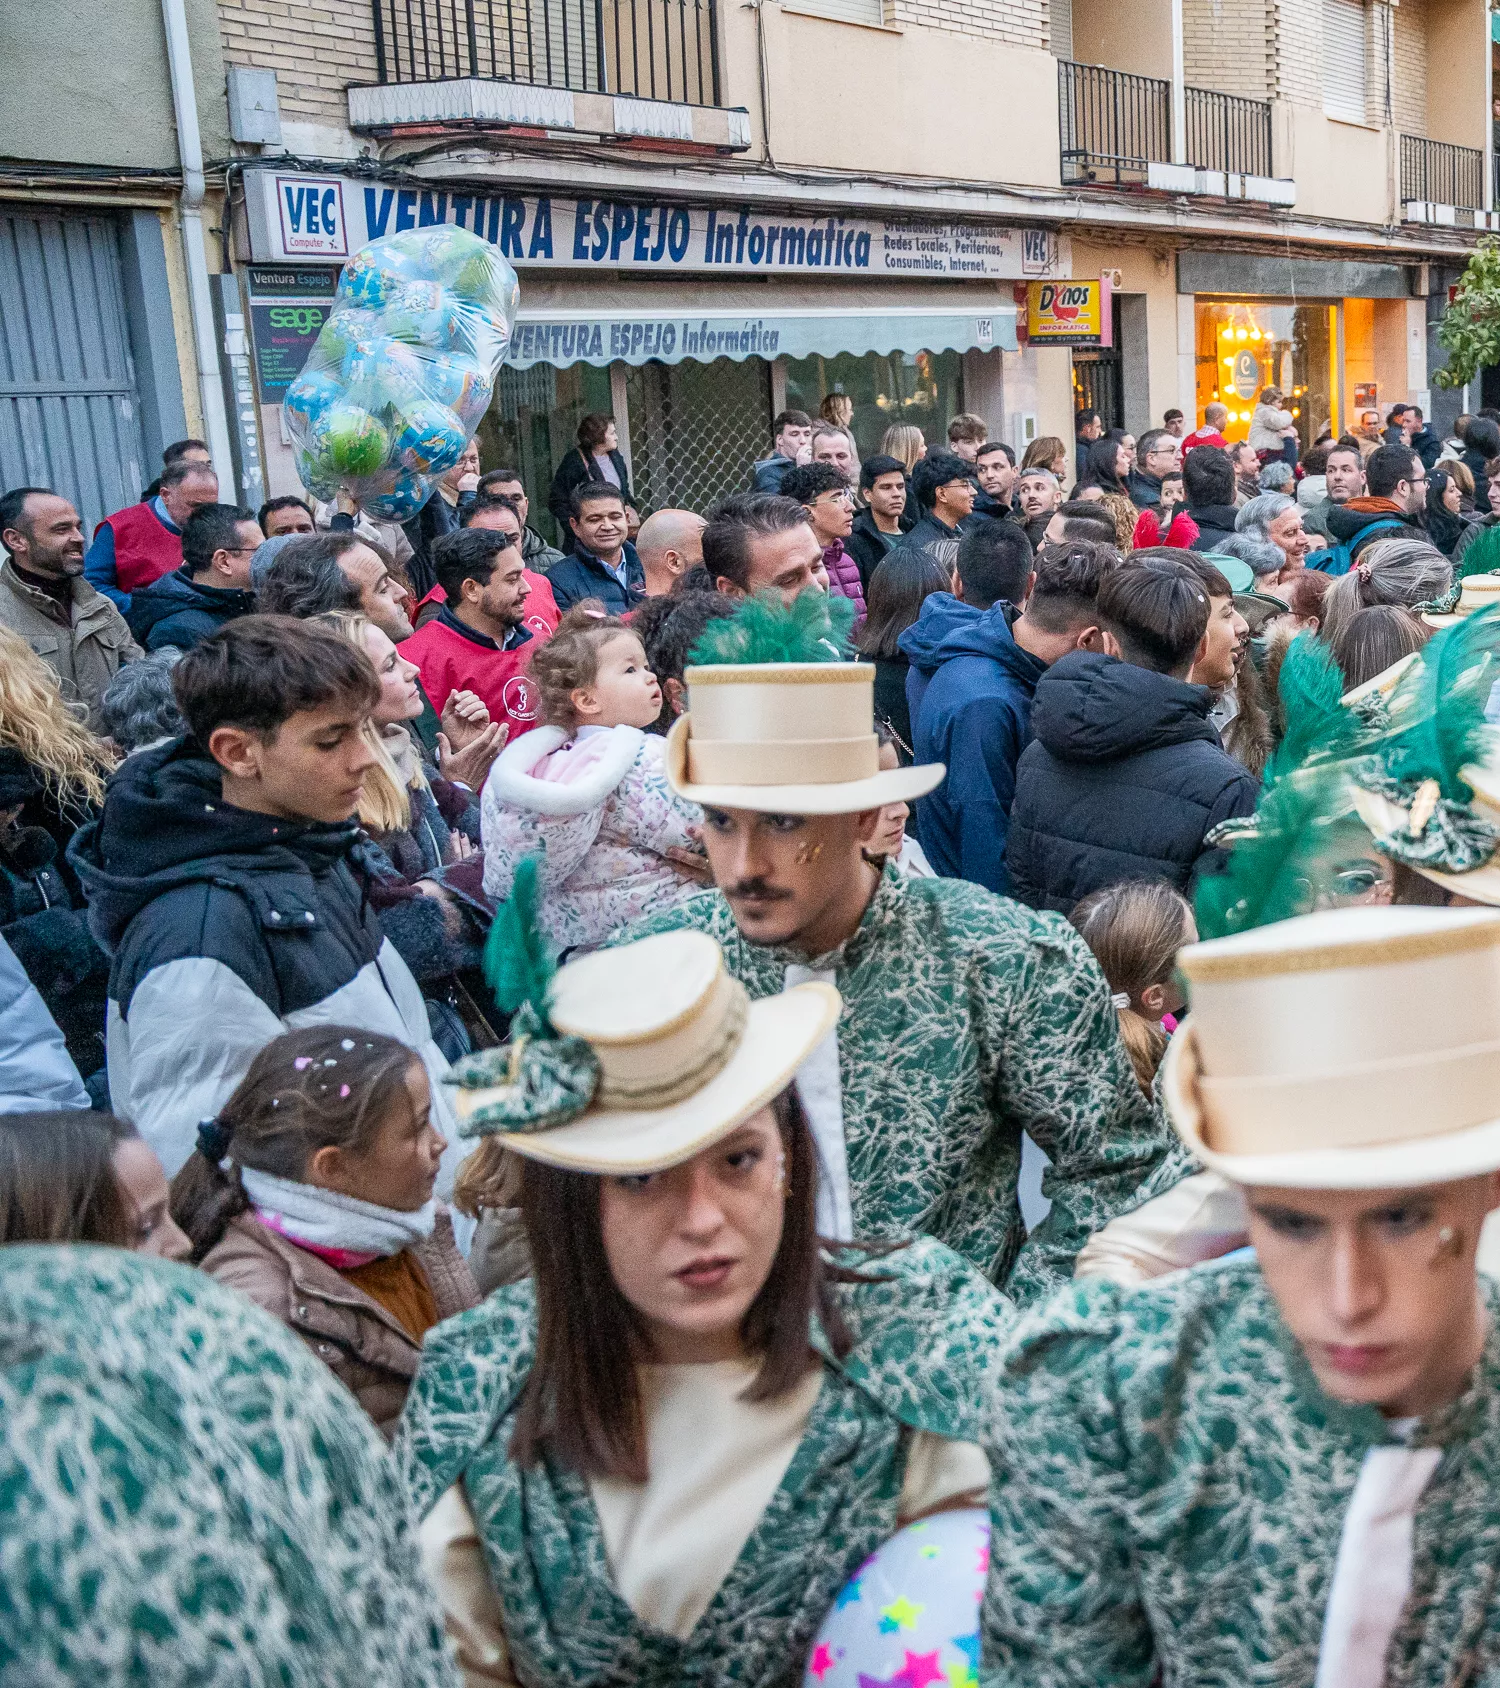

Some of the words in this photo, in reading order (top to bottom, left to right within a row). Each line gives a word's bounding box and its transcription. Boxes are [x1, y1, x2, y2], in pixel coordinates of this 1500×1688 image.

[284, 186, 336, 236] VEC
[363, 187, 554, 259] VENTURA
[572, 200, 691, 263] ESPEJO
[704, 206, 871, 267] Informática
[289, 237, 324, 249] Computer
[884, 235, 912, 250] Redes
[916, 237, 951, 255] Locales,
[955, 239, 1003, 257] Periféricos,
[1025, 231, 1046, 262] VEC
[885, 253, 946, 272] Consumibles,
[950, 257, 987, 273] Internet,
[253, 272, 295, 284] Ventura
[297, 273, 331, 287] Espejo
[269, 308, 323, 335] sage
[977, 320, 990, 337] VEC
[509, 324, 604, 360] VENTURA
[610, 323, 676, 356] ESPEJO
[682, 320, 779, 353] Informática
